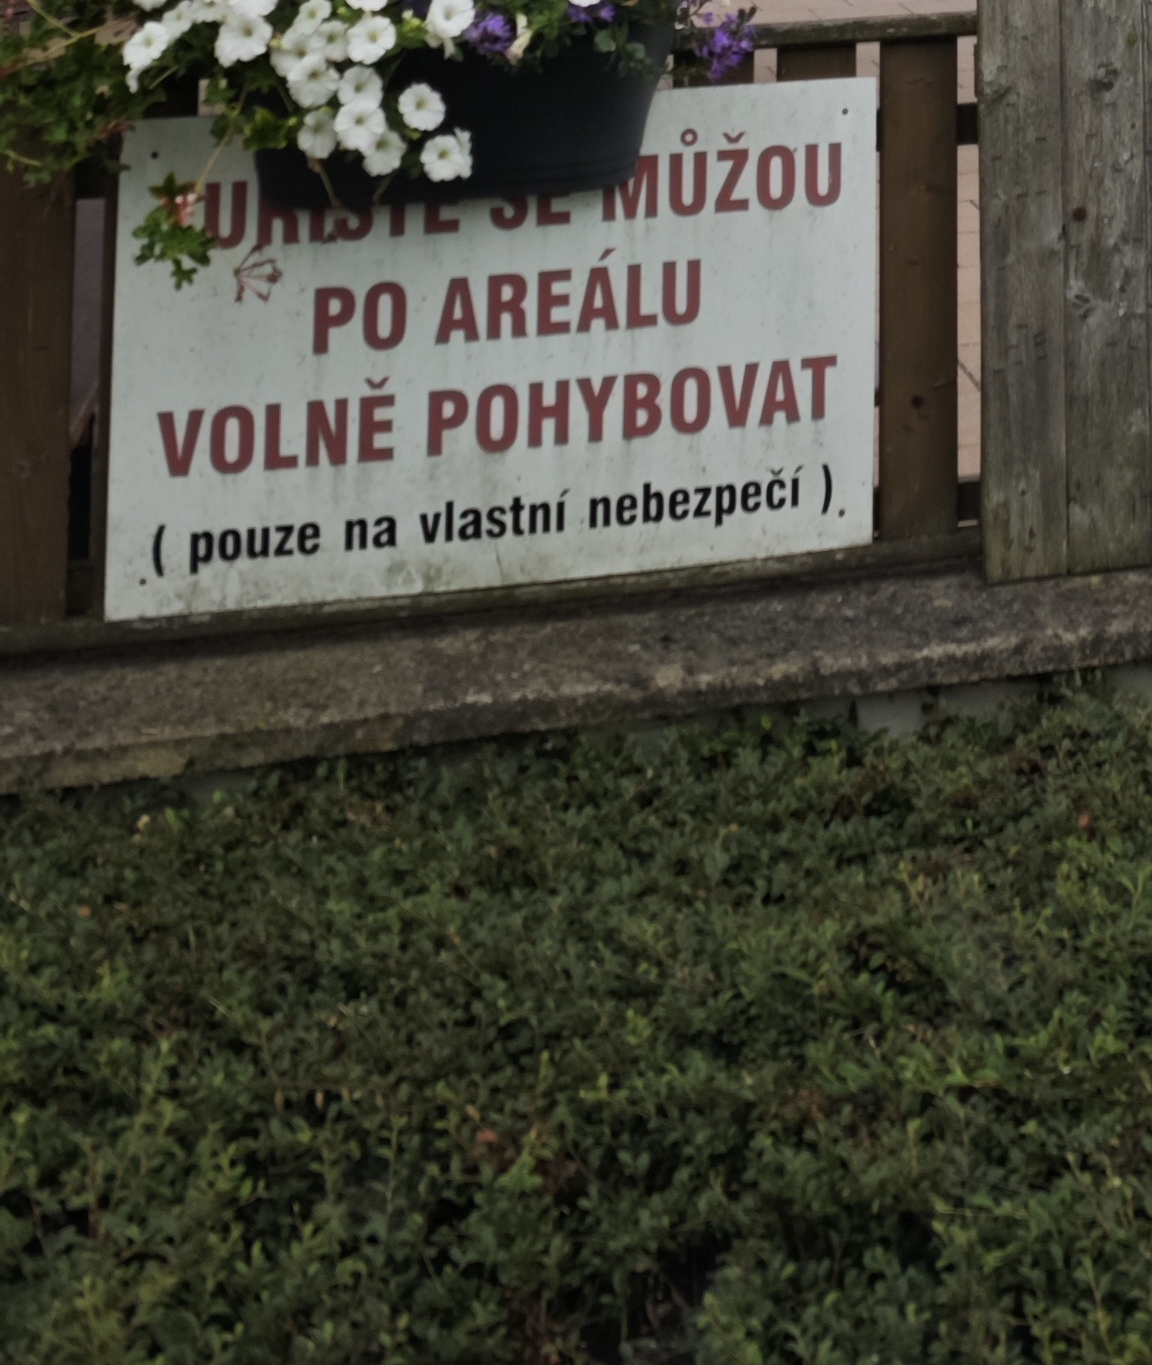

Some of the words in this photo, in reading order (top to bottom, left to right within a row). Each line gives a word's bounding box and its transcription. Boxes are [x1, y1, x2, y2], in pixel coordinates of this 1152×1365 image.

[602, 128, 844, 219] MŮŽOU
[312, 282, 407, 355] PO
[435, 248, 703, 345] AREÁLU
[158, 376, 396, 478] VOLNĚ
[425, 355, 839, 458] POHYBOVAT
[189, 521, 322, 575] pouze
[344, 516, 398, 552] na
[419, 490, 567, 545] vlastní
[589, 465, 804, 530] nebezpečí
